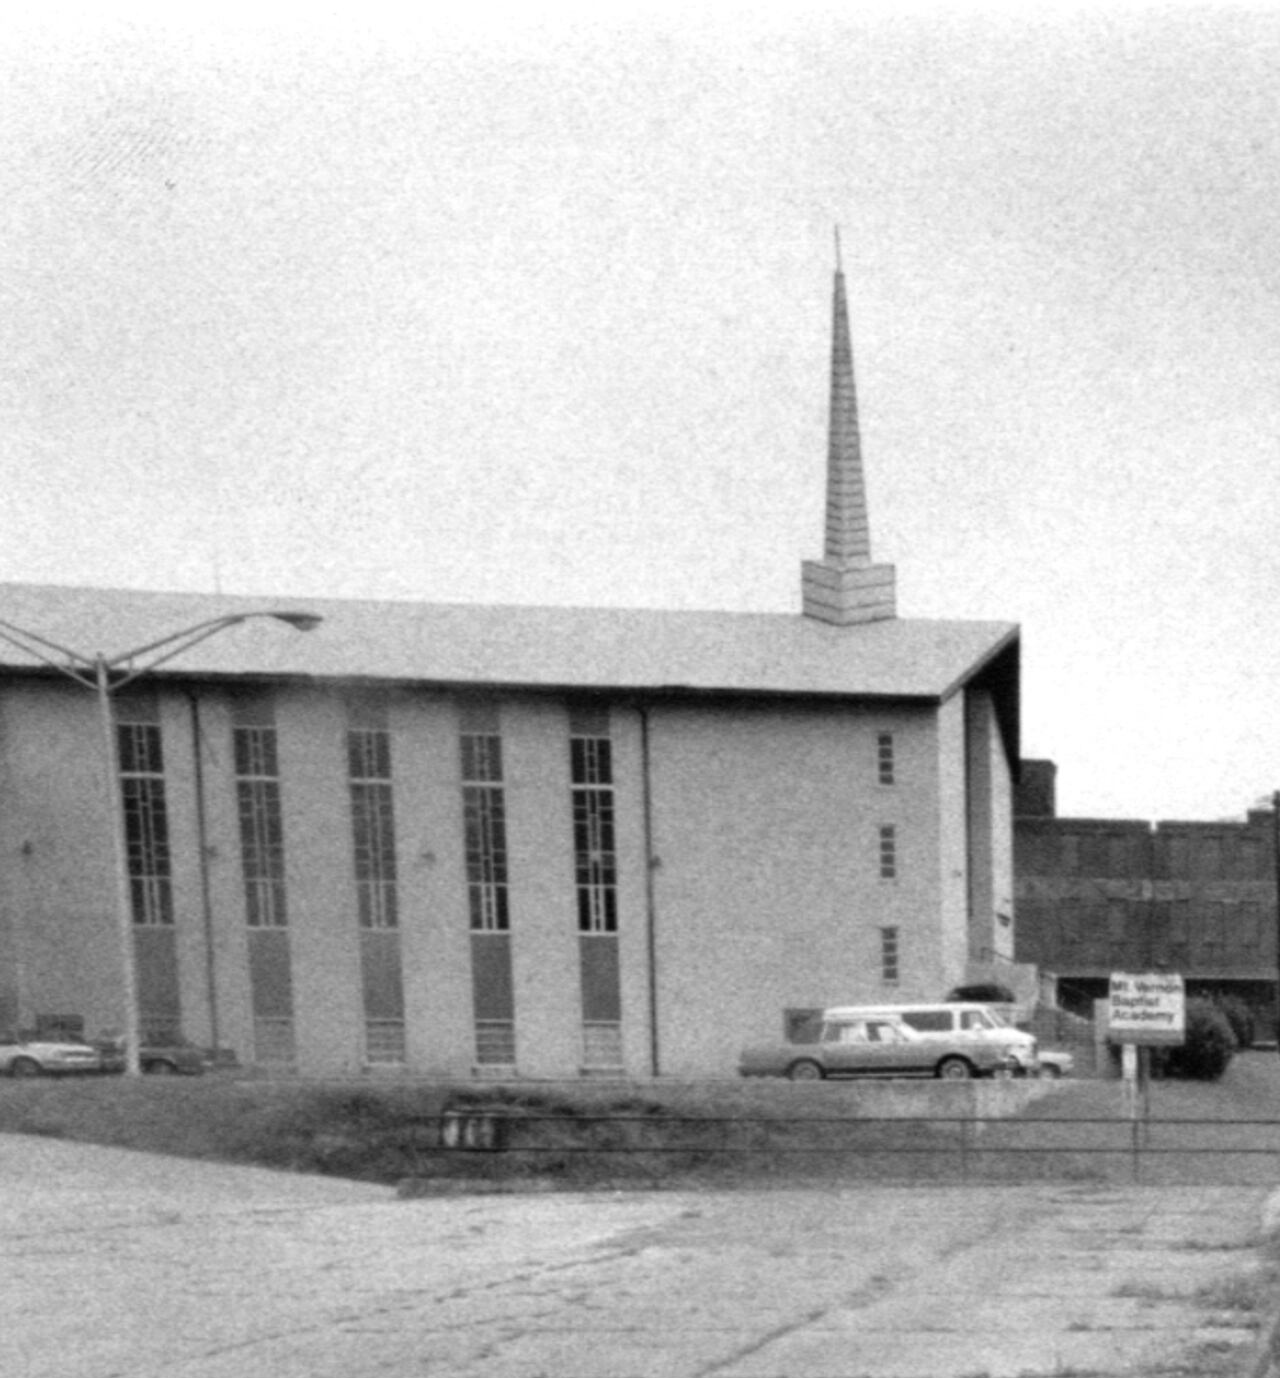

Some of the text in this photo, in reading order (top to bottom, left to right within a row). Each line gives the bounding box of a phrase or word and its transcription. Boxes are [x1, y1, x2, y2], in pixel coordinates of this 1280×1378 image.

[1135, 981, 1182, 993] Vernon
[1112, 995, 1160, 1008] Baptist
[1112, 1010, 1175, 1024] Academy
